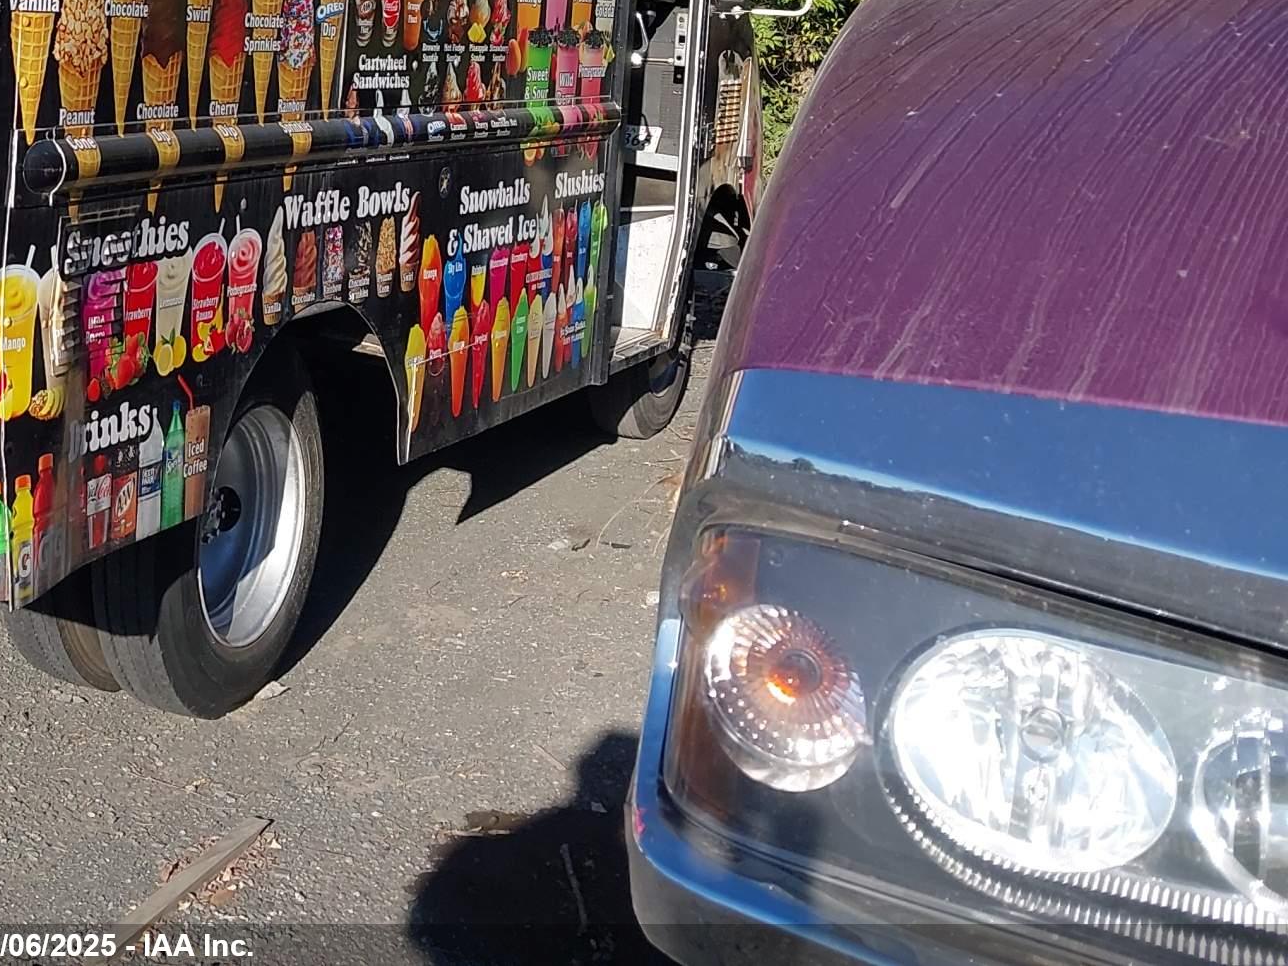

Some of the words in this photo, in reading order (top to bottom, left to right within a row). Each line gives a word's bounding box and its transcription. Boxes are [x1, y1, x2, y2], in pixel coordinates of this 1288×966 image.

[186, 4, 211, 22] Swirl
[316, 1, 345, 20] OREO
[244, 12, 285, 28] Chocolate
[322, 23, 337, 38] Dip
[243, 37, 281, 54] Sprinkles
[358, 54, 407, 71] Cartwheel
[353, 72, 410, 90] Sandwiches
[527, 67, 549, 83] Sweet
[136, 103, 179, 119] Chocolate
[209, 101, 239, 117] Cherry
[277, 98, 306, 114] Rainbow
[59, 108, 96, 126] Peanut
[218, 124, 238, 139] Dip
[65, 135, 97, 151] Cone
[554, 168, 605, 199] Slushies
[459, 177, 531, 215] Snowballs
[283, 189, 351, 230] Waffle
[357, 181, 410, 218] Bowls
[447, 228, 458, 257] &
[463, 216, 514, 254] Shaved
[517, 214, 537, 242] Ice
[64, 215, 190, 275] Smoothies
[1, 337, 26, 352] Mango
[187, 439, 204, 457] Iced
[183, 458, 208, 478] Coffee
[17, 543, 33, 578] G
